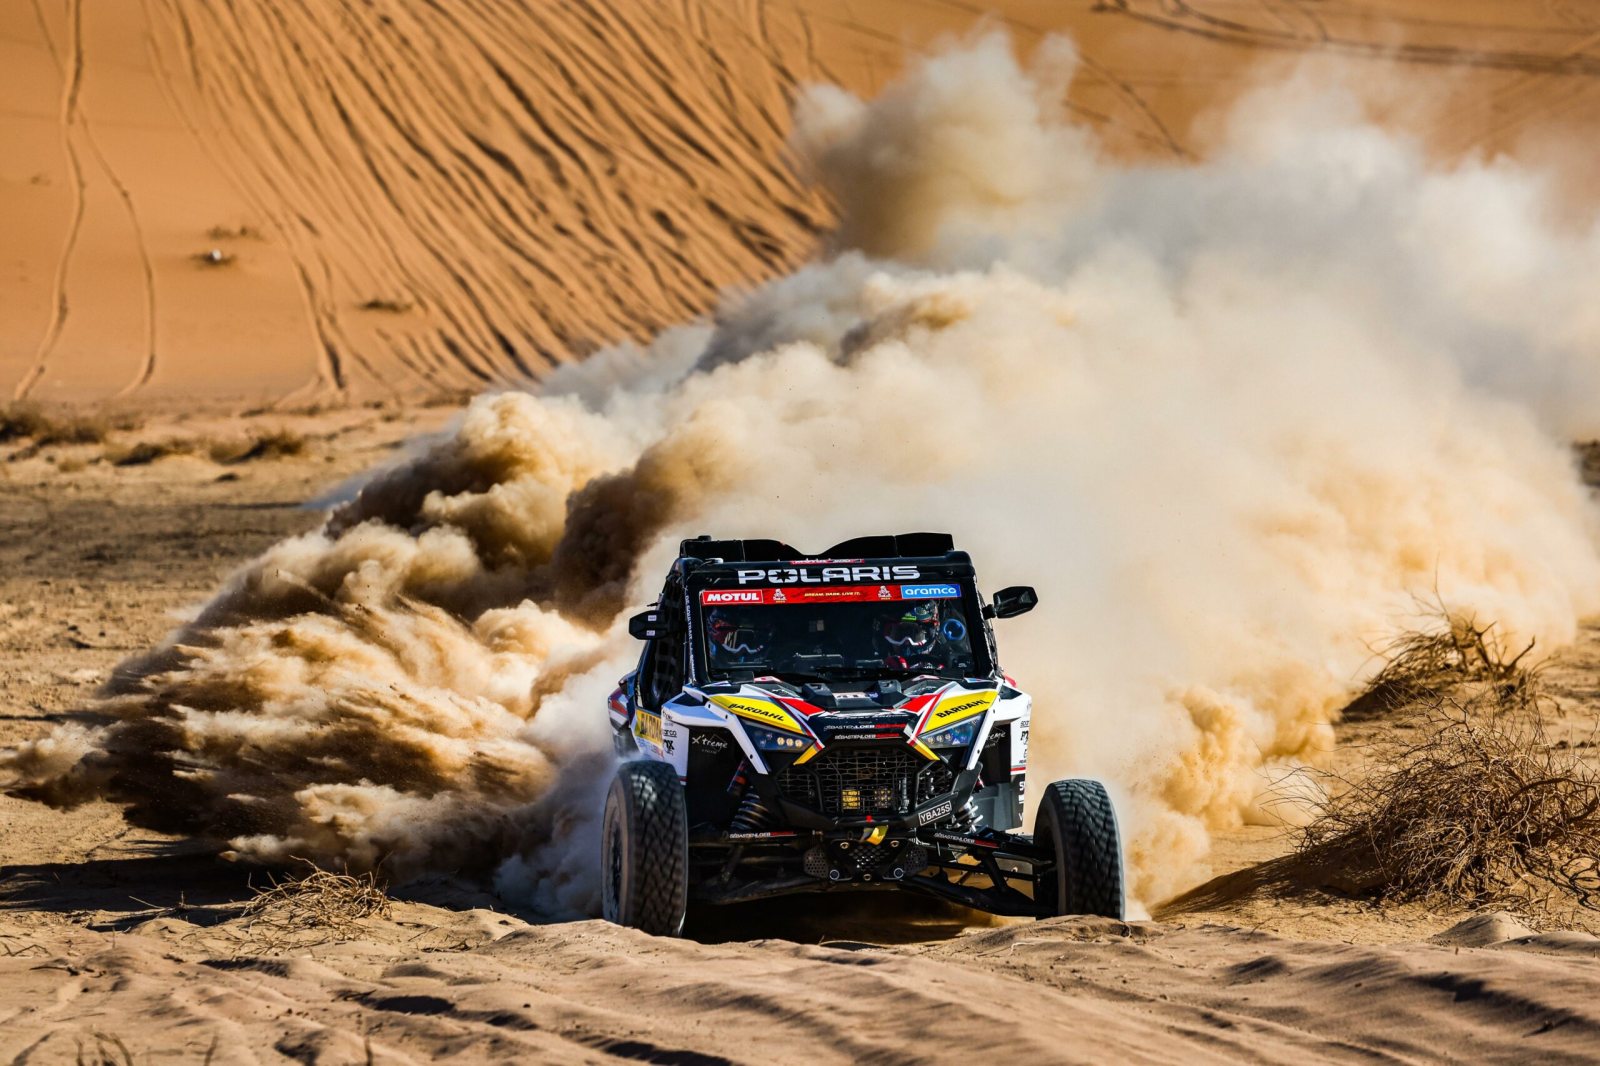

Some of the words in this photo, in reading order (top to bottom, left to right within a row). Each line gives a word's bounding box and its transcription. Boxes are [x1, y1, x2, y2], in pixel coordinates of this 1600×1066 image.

[737, 565, 921, 585] POLARIS
[707, 592, 760, 602] MOTUL
[904, 586, 957, 596] aramco
[728, 703, 784, 722] BARDAHL
[935, 699, 991, 718] BARDAHL
[920, 803, 951, 822] YBA25S
